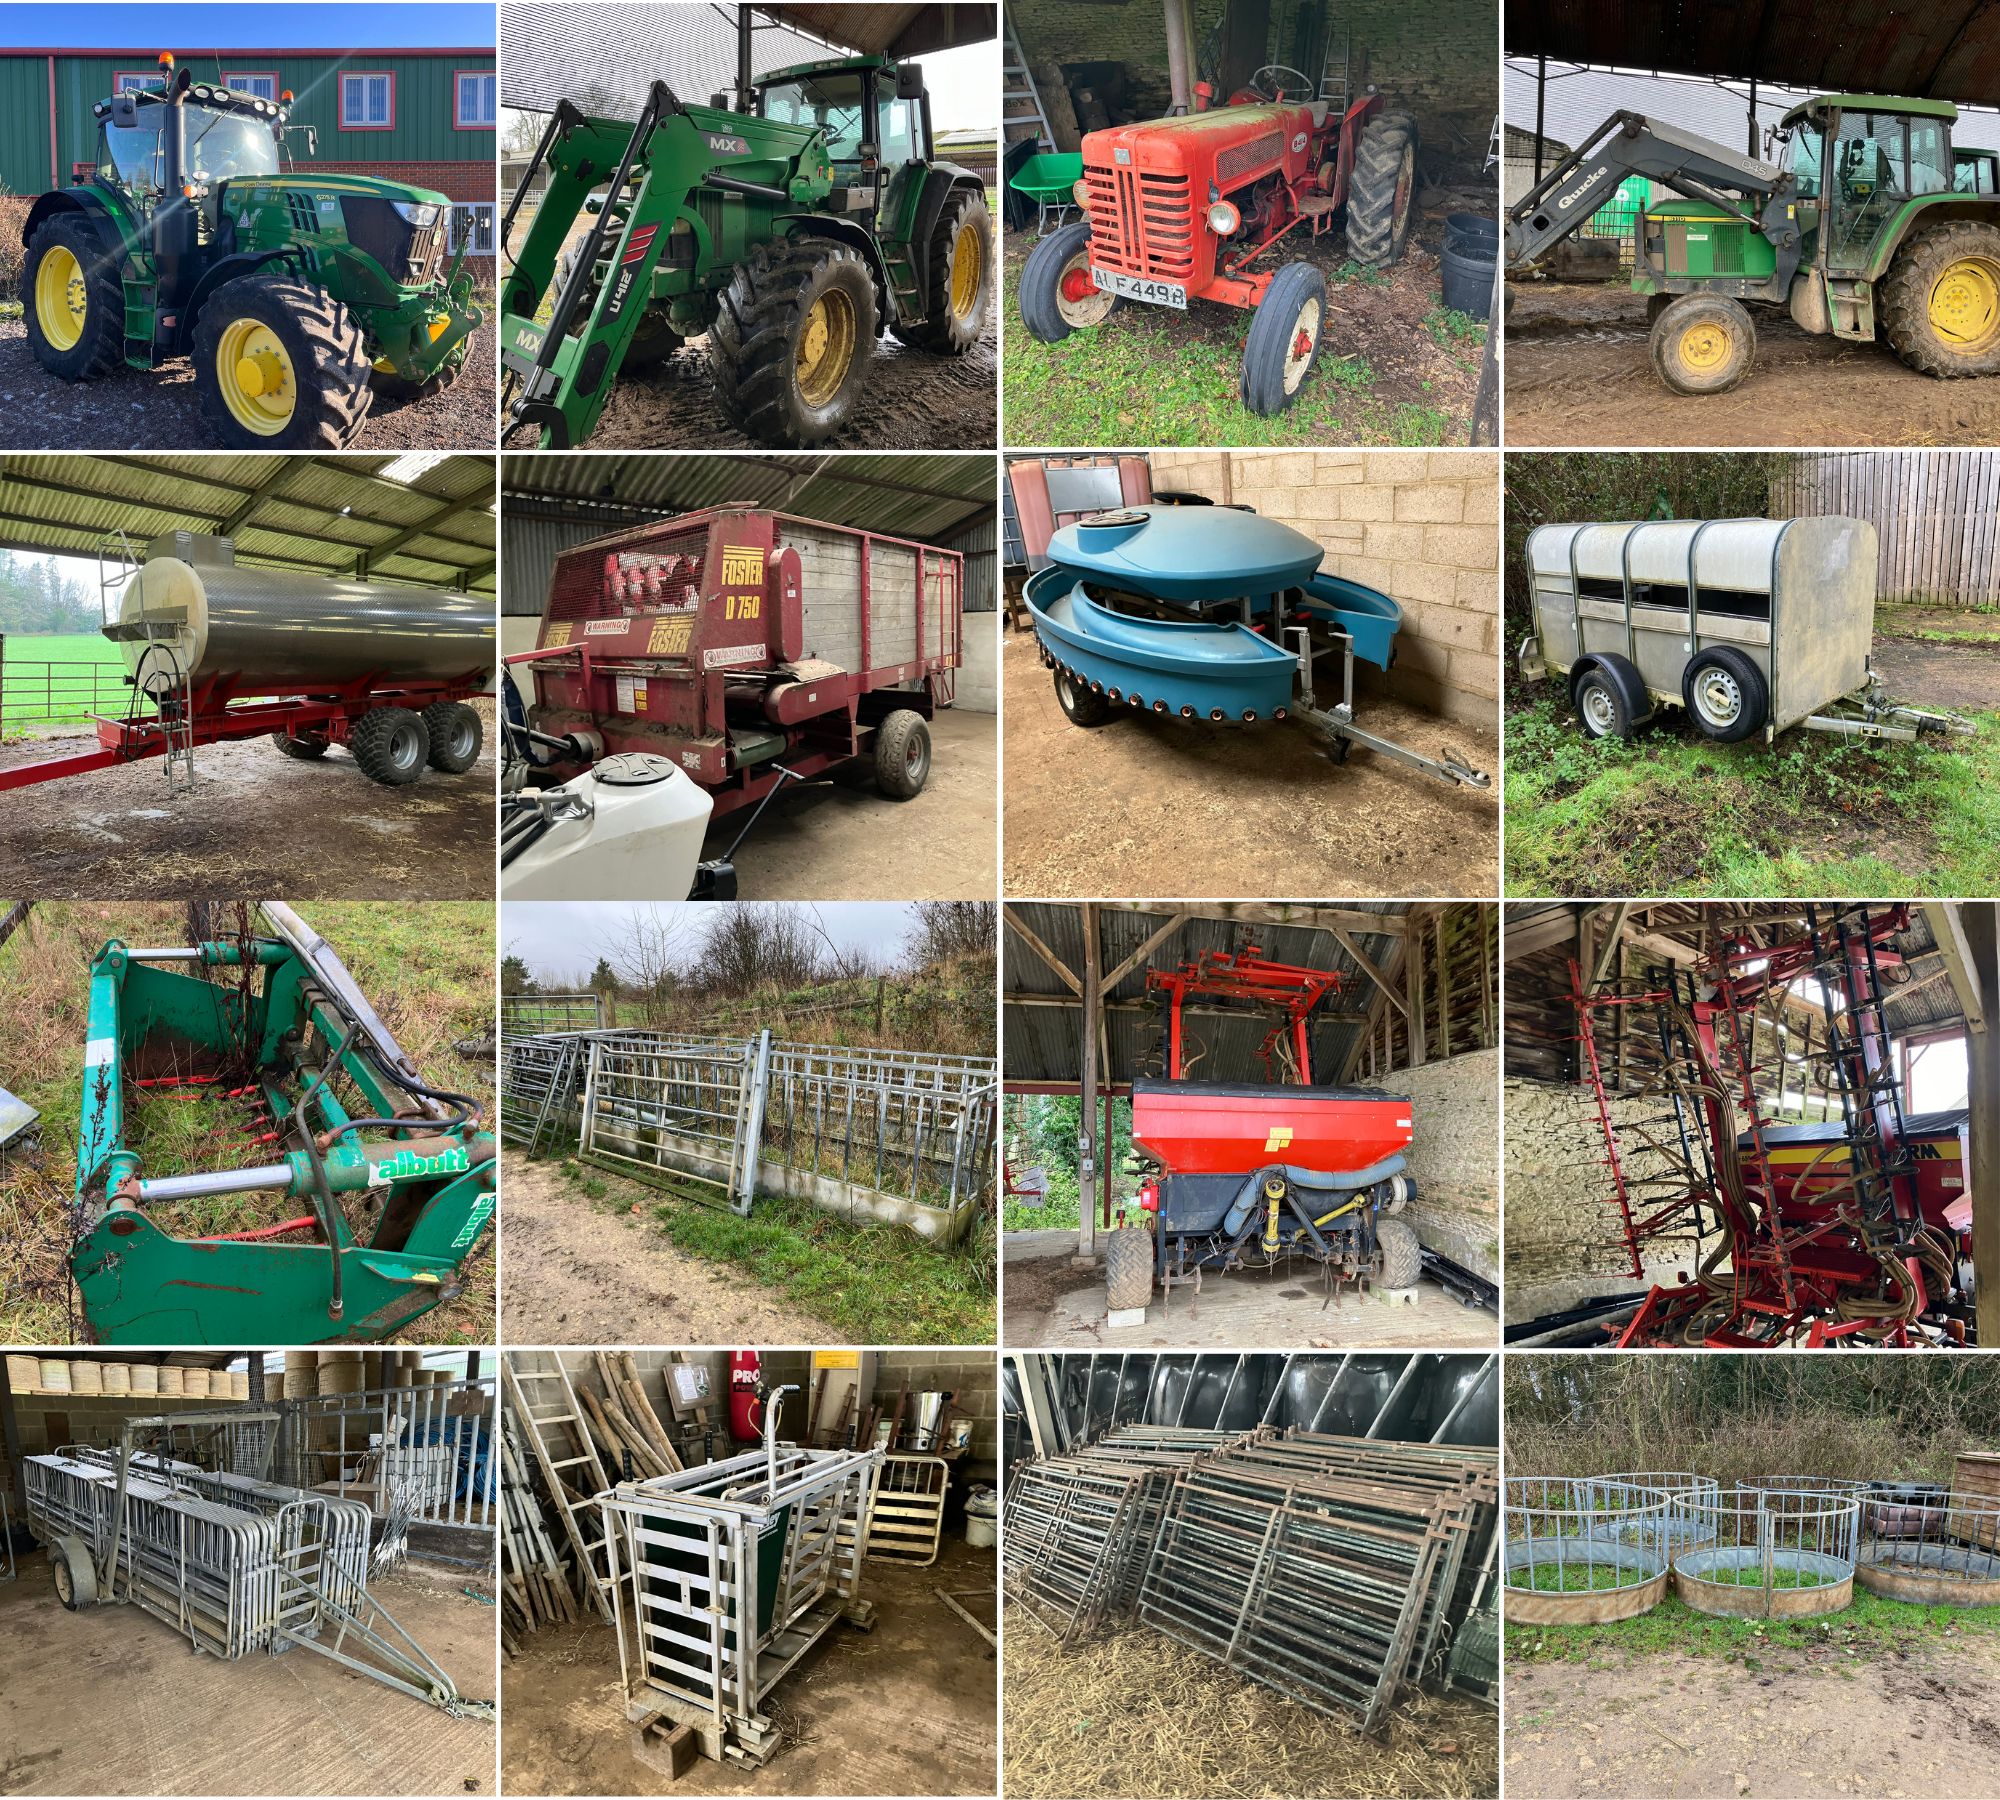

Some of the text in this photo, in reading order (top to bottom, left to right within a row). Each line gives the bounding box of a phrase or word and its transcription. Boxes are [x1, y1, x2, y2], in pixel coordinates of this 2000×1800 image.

[710, 136, 736, 152] MX
[1558, 166, 1608, 209] Quicke
[515, 329, 543, 354] MX
[721, 559, 763, 586] FOSTER
[725, 595, 761, 620] D 750
[592, 621, 622, 630] WARNING
[646, 628, 692, 654] FOSTER
[716, 647, 757, 659] WARNING
[378, 1147, 470, 1178] albutt
[453, 1197, 495, 1247] albutt
[733, 1369, 760, 1383] PRO
